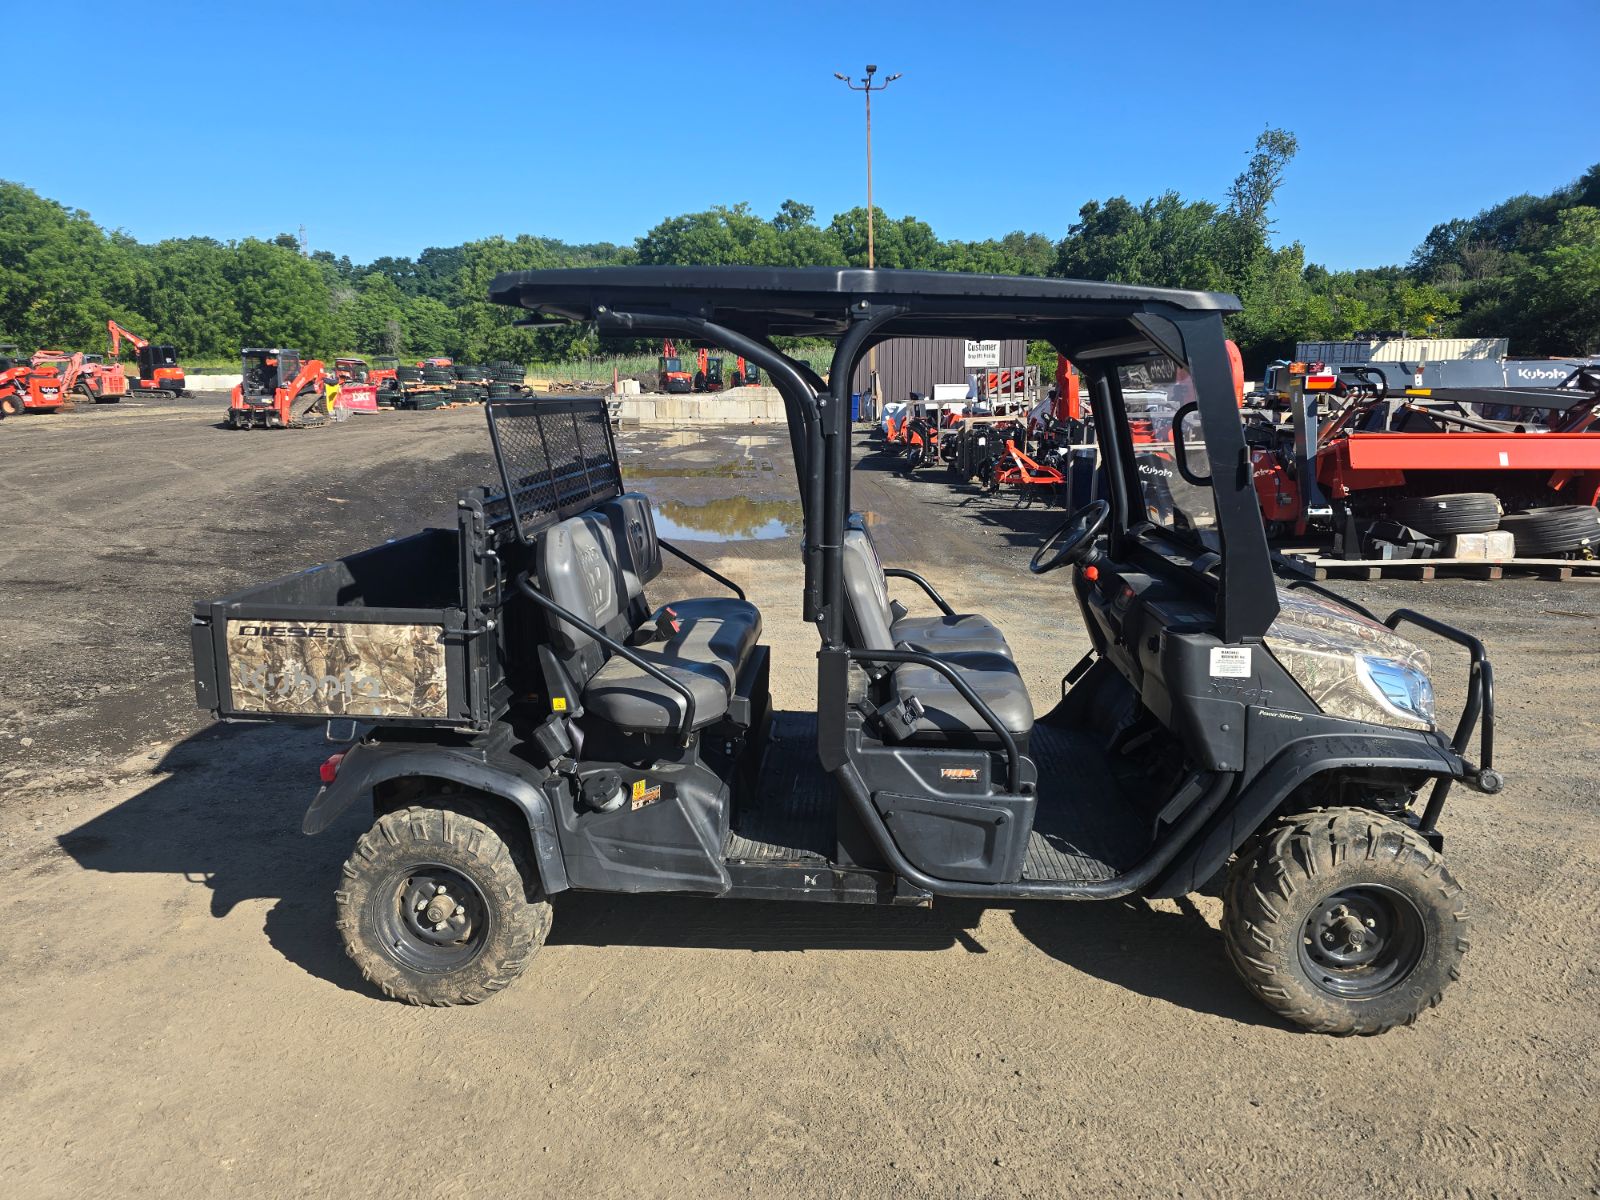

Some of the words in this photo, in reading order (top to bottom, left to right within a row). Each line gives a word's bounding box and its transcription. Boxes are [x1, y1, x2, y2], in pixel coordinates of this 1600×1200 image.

[968, 343, 996, 351] Customer
[1518, 368, 1567, 379] Kubota
[1138, 464, 1173, 478] Kubota
[239, 625, 346, 638] DIESEL
[239, 661, 380, 698] Kubota
[1279, 712, 1303, 721] Steering
